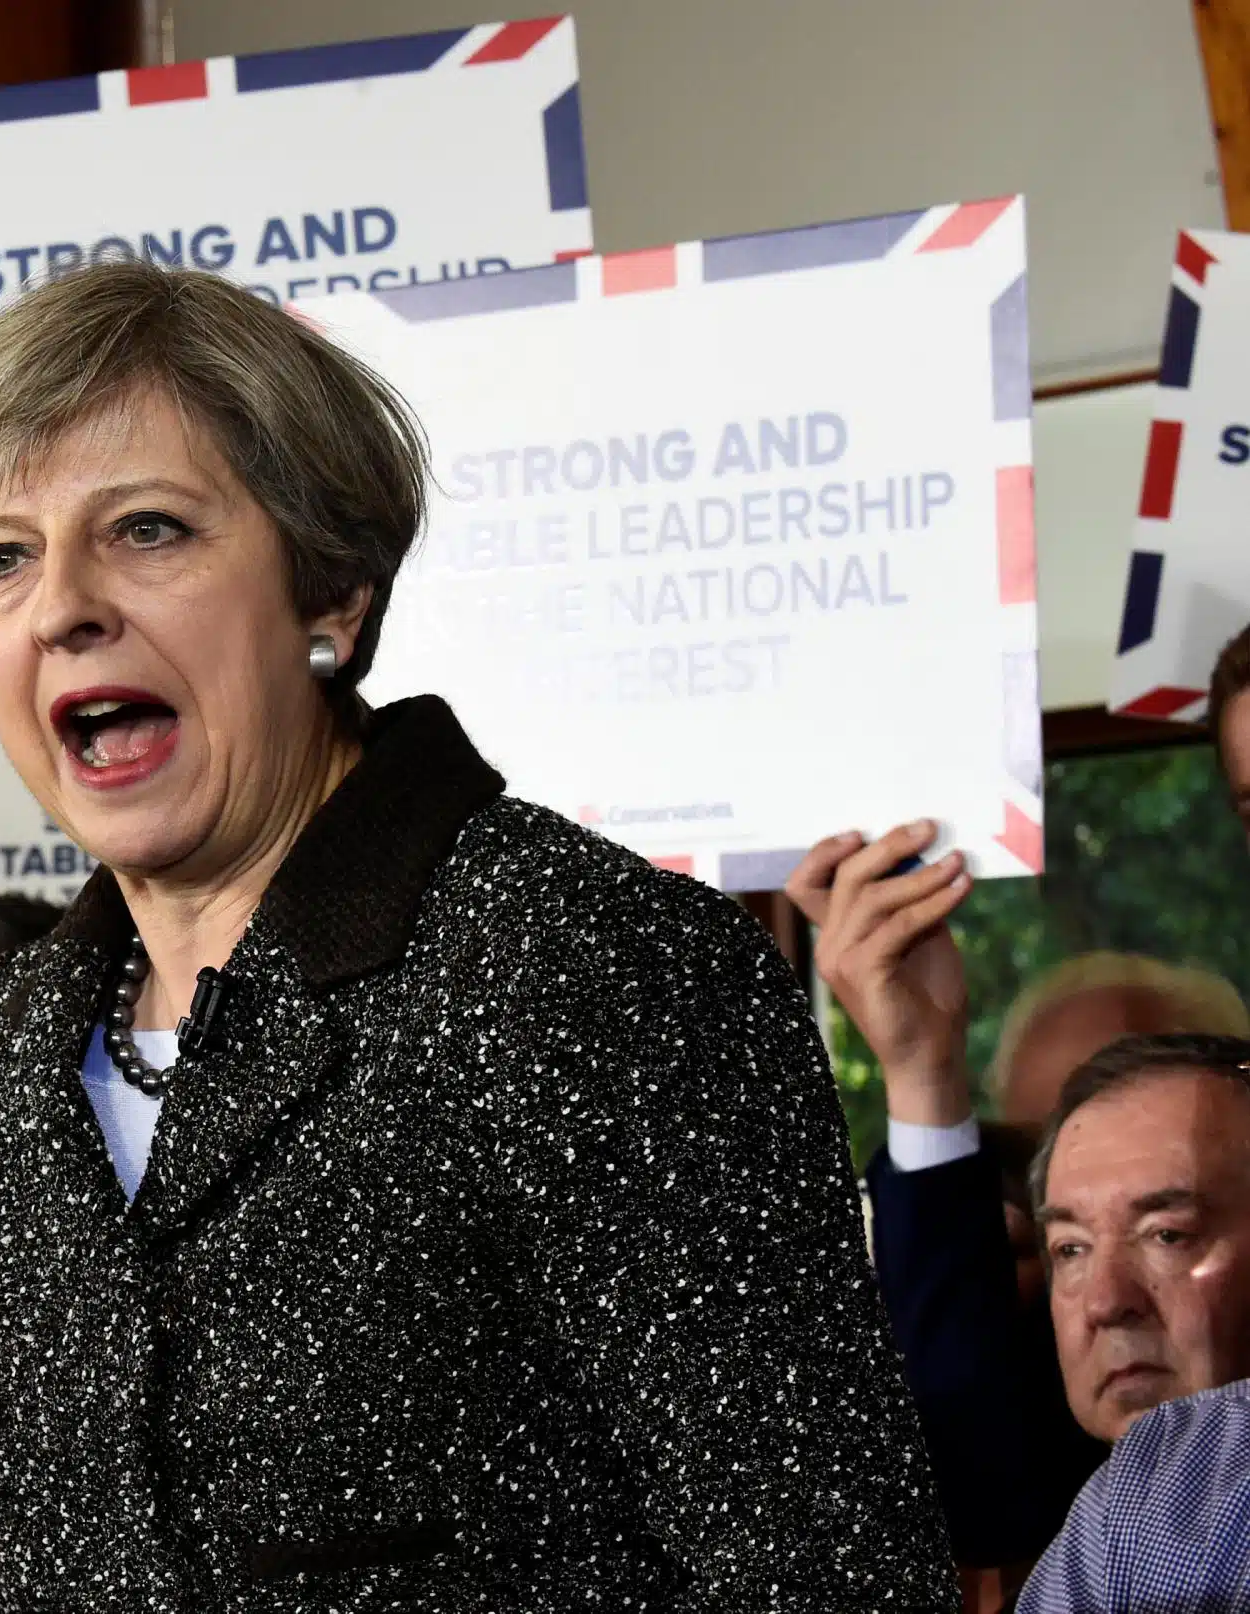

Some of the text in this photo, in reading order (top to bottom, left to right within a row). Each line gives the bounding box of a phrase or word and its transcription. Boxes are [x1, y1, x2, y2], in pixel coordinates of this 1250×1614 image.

[255, 205, 399, 267] AND
[449, 410, 849, 502] STRONG AND
[586, 470, 956, 562] LEADERSHIP
[608, 549, 911, 628] NATIONAL
